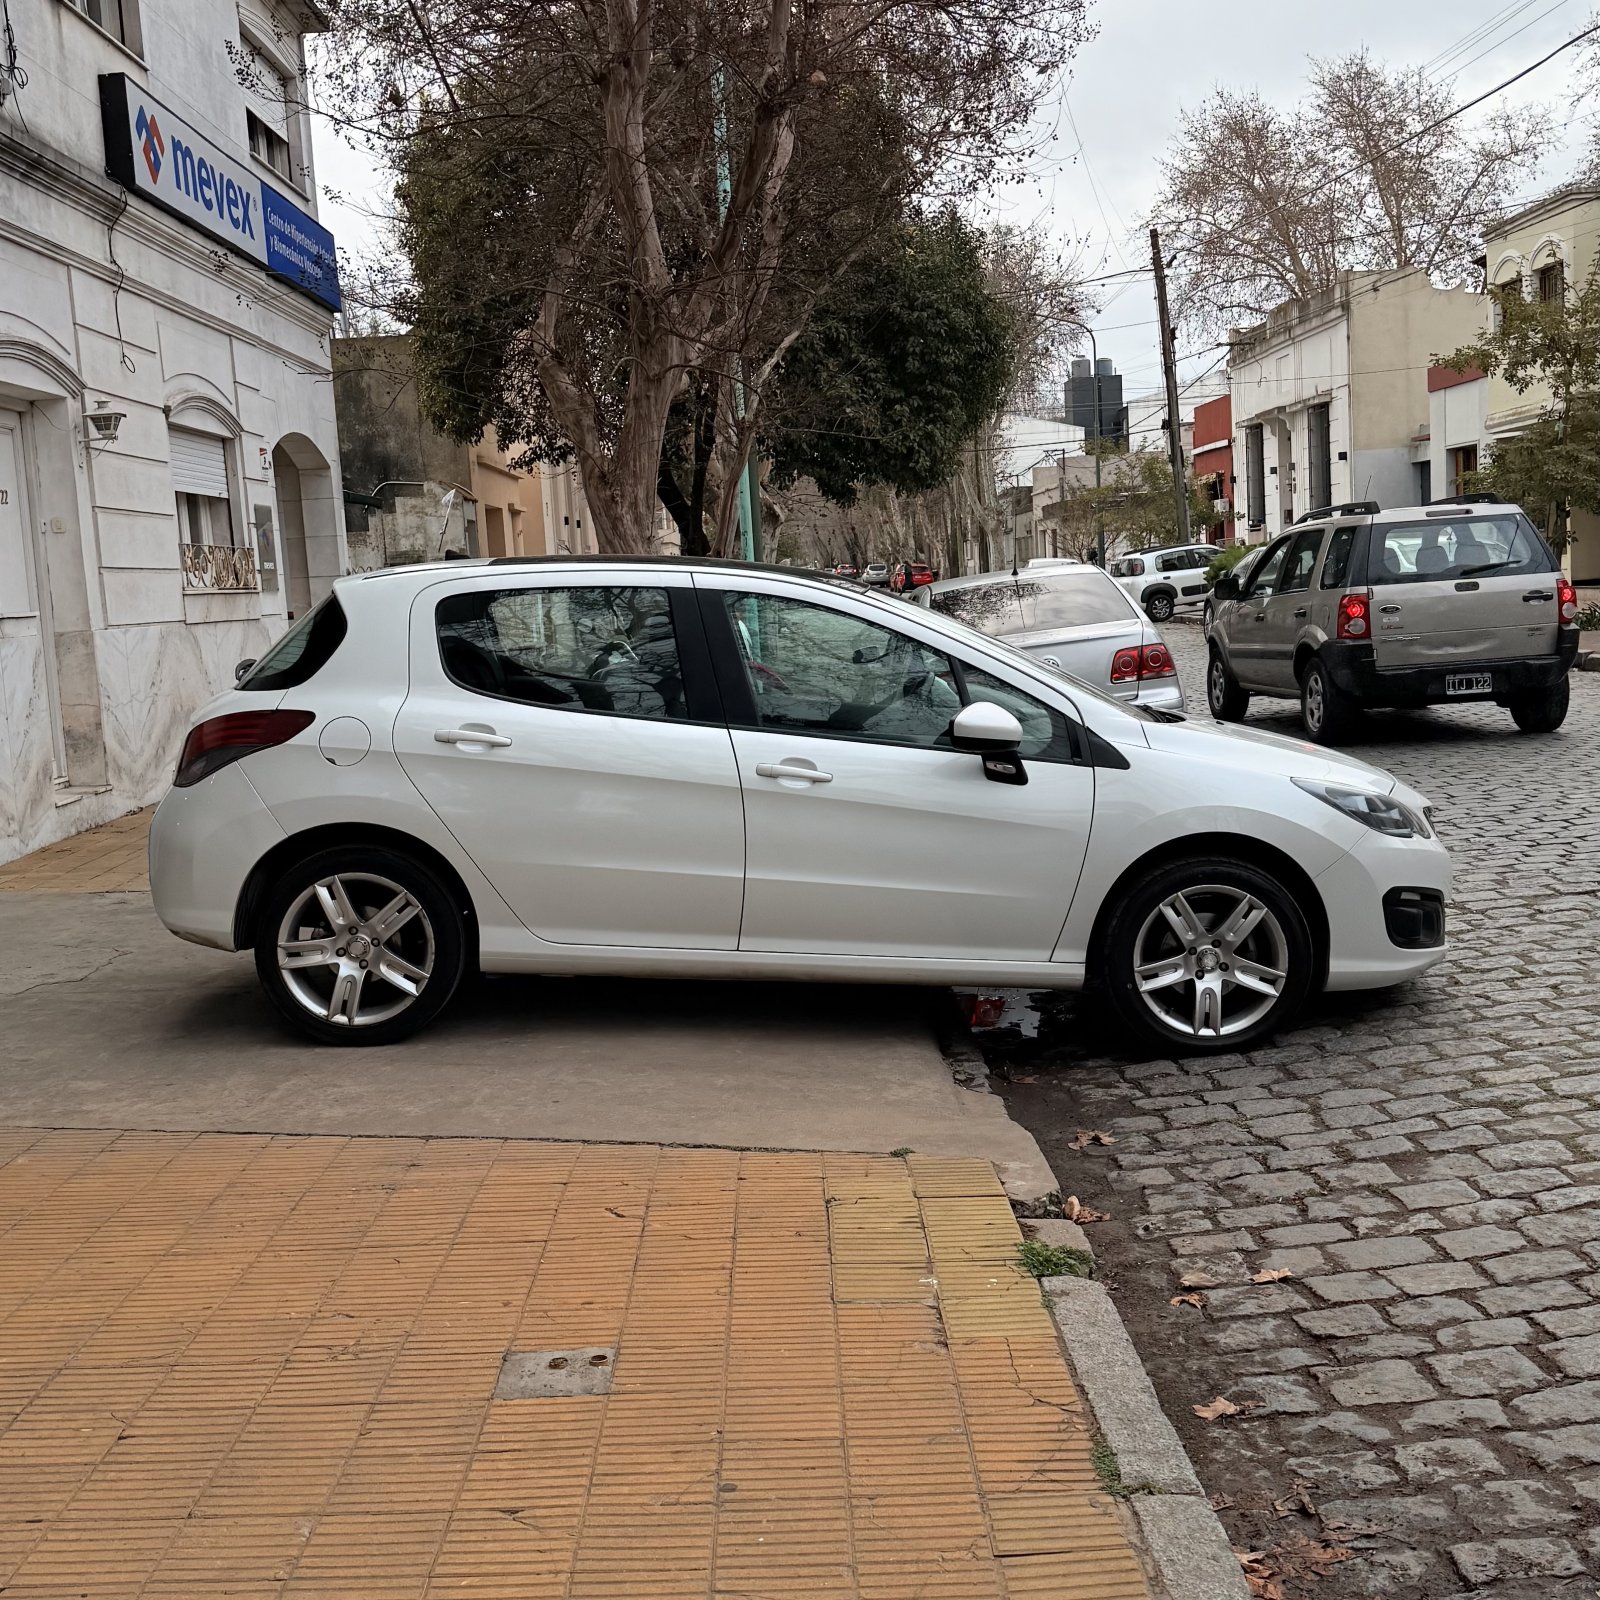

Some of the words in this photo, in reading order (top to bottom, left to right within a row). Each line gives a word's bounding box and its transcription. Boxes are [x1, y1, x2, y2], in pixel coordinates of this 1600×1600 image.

[171, 134, 255, 241] mevex
[267, 207, 284, 232] Centro
[284, 219, 291, 237] de
[269, 235, 274, 252] y
[1448, 678, 1466, 691] ITJ
[1471, 677, 1490, 690] 122
